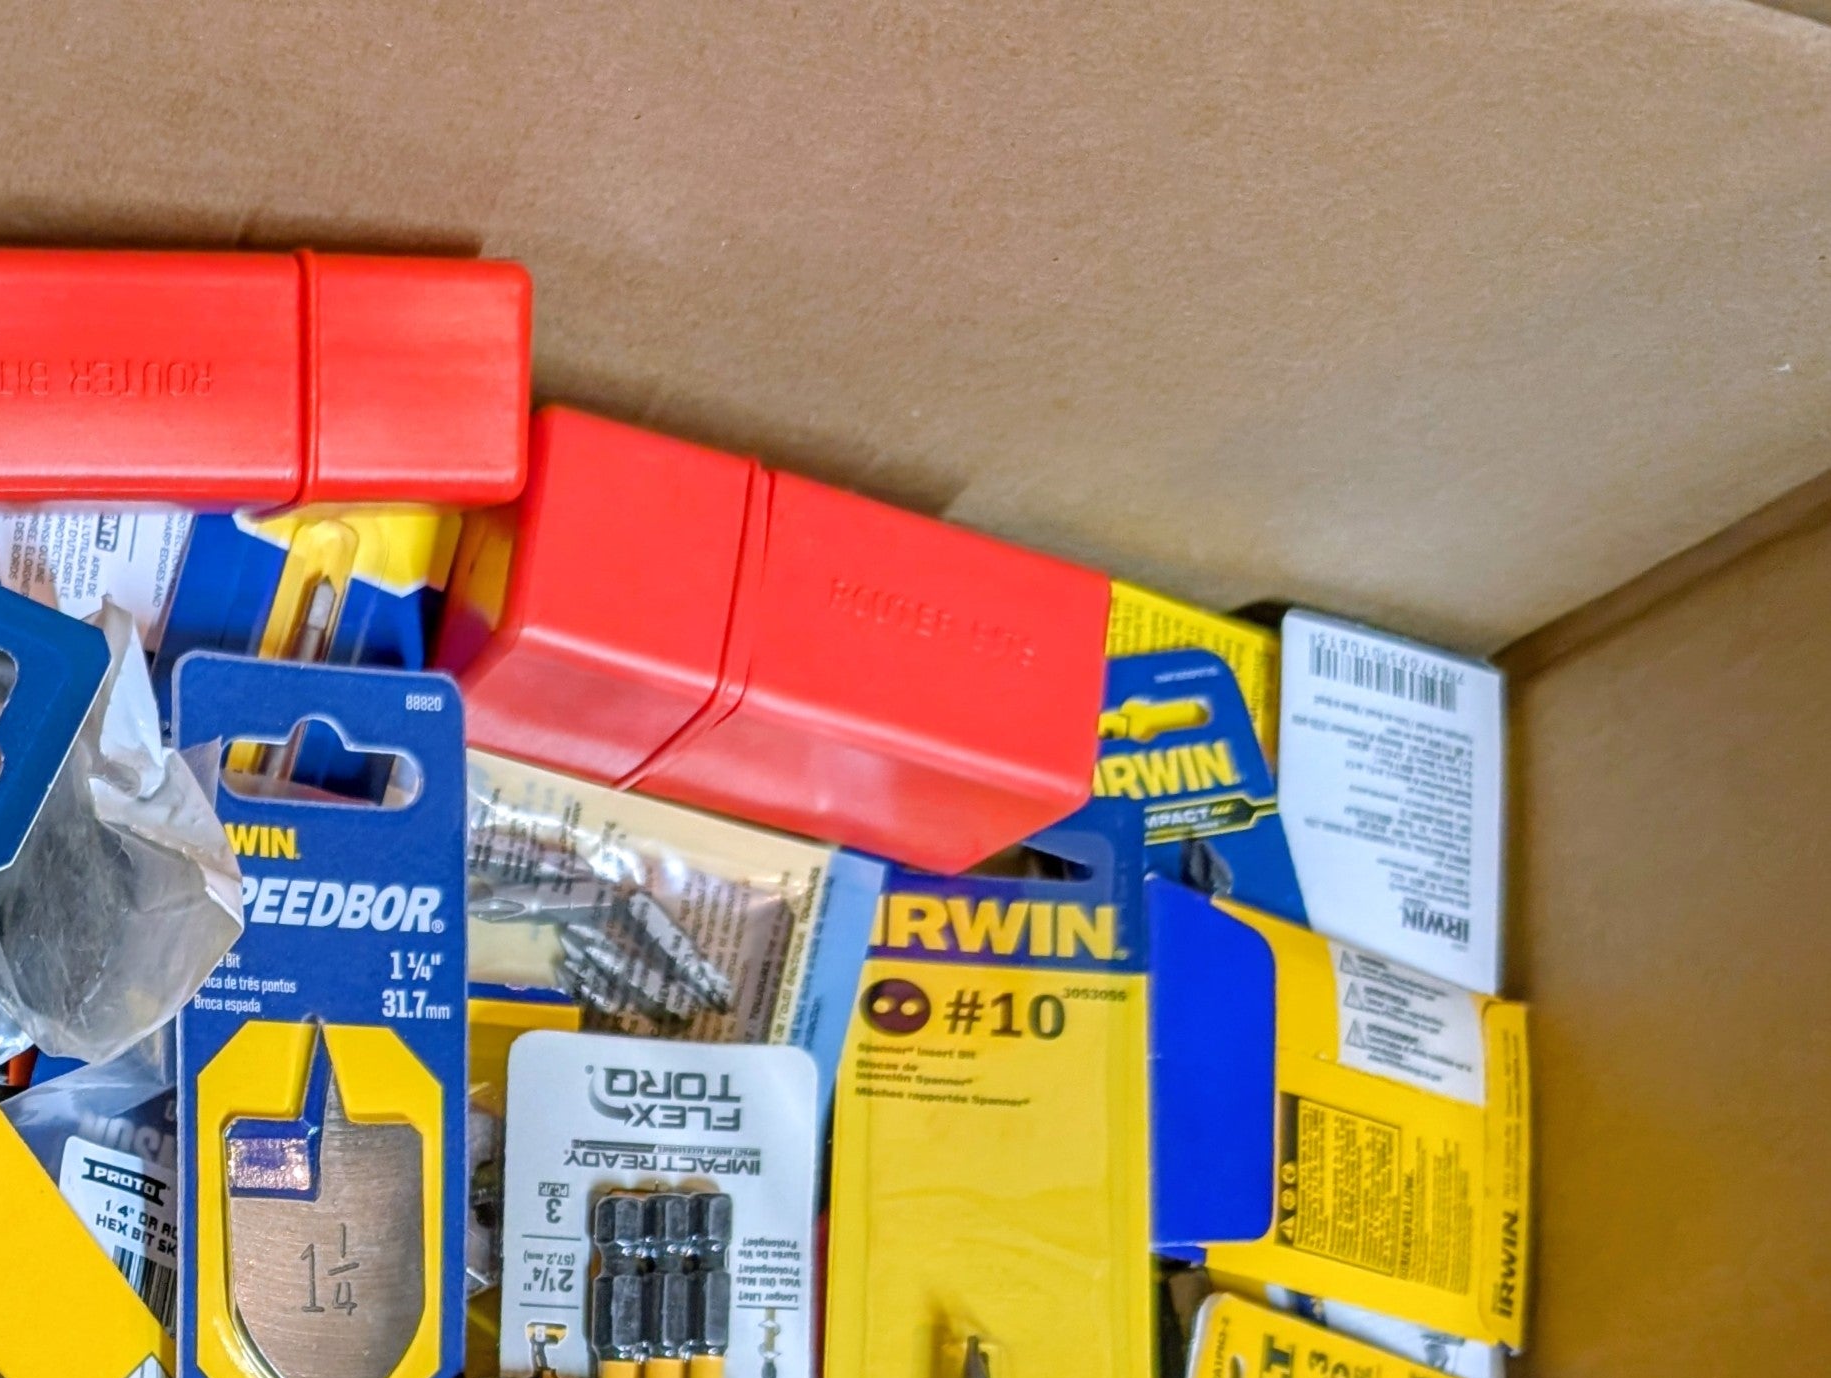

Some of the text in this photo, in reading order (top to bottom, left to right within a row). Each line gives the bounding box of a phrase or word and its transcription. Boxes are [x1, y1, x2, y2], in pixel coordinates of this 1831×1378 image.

[1402, 904, 1470, 943] IRWIN
[943, 987, 1067, 1041] #10
[603, 1067, 742, 1103] TORQ
[631, 1103, 742, 1132] FLEX
[93, 1165, 157, 1197] PROTO
[544, 1199, 563, 1225] 3
[95, 1213, 155, 1247] HEX BIT
